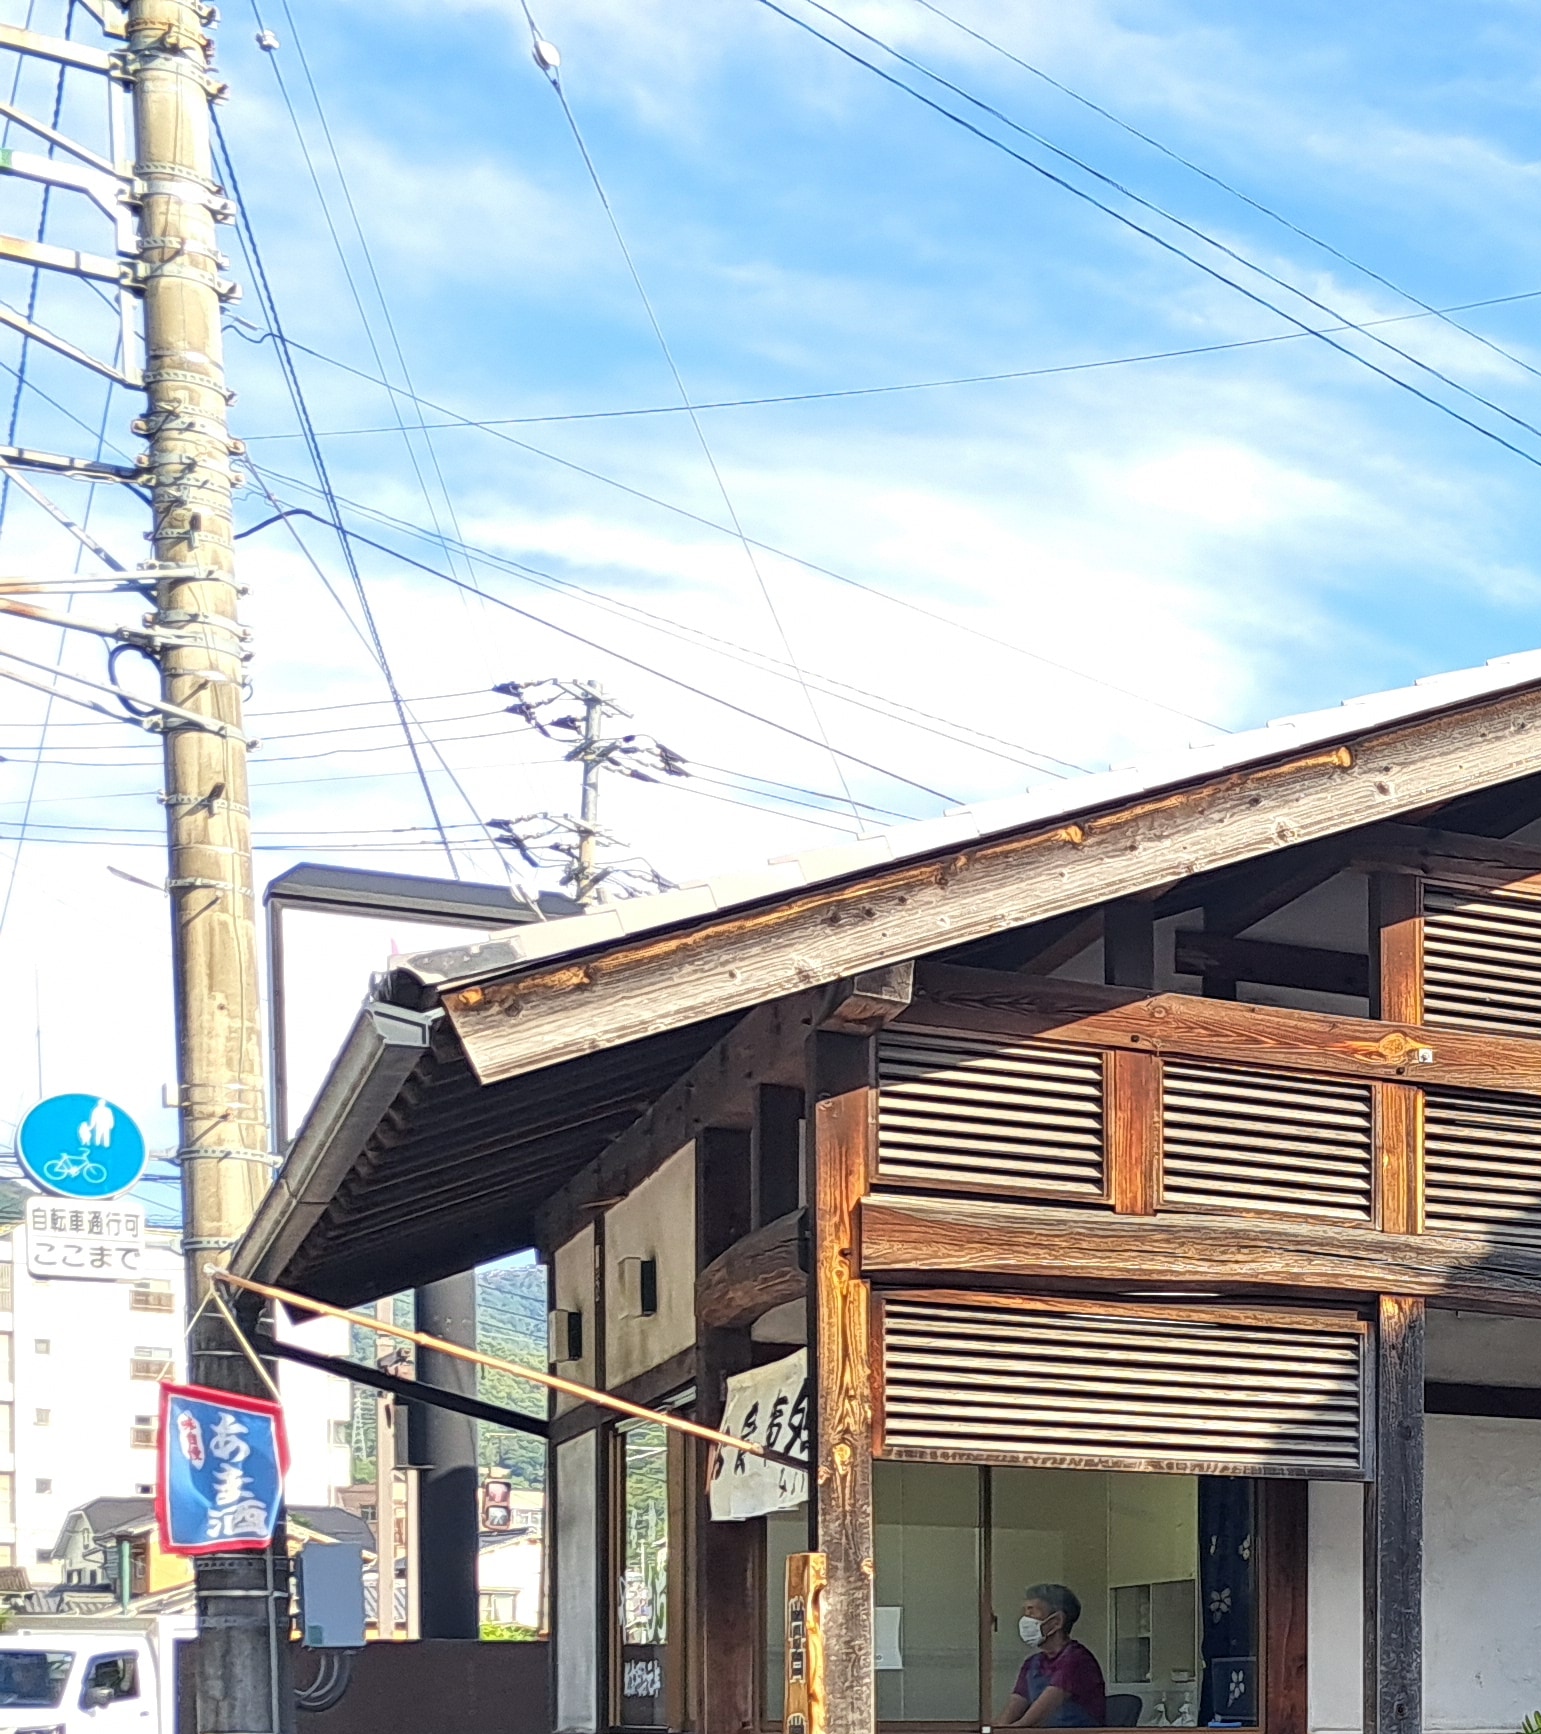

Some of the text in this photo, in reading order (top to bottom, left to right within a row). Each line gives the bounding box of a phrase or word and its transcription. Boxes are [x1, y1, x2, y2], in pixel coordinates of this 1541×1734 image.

[32, 1207, 140, 1238] 自転車通行可
[34, 1243, 141, 1270] ここまで
[206, 1412, 270, 1538] あま酒
